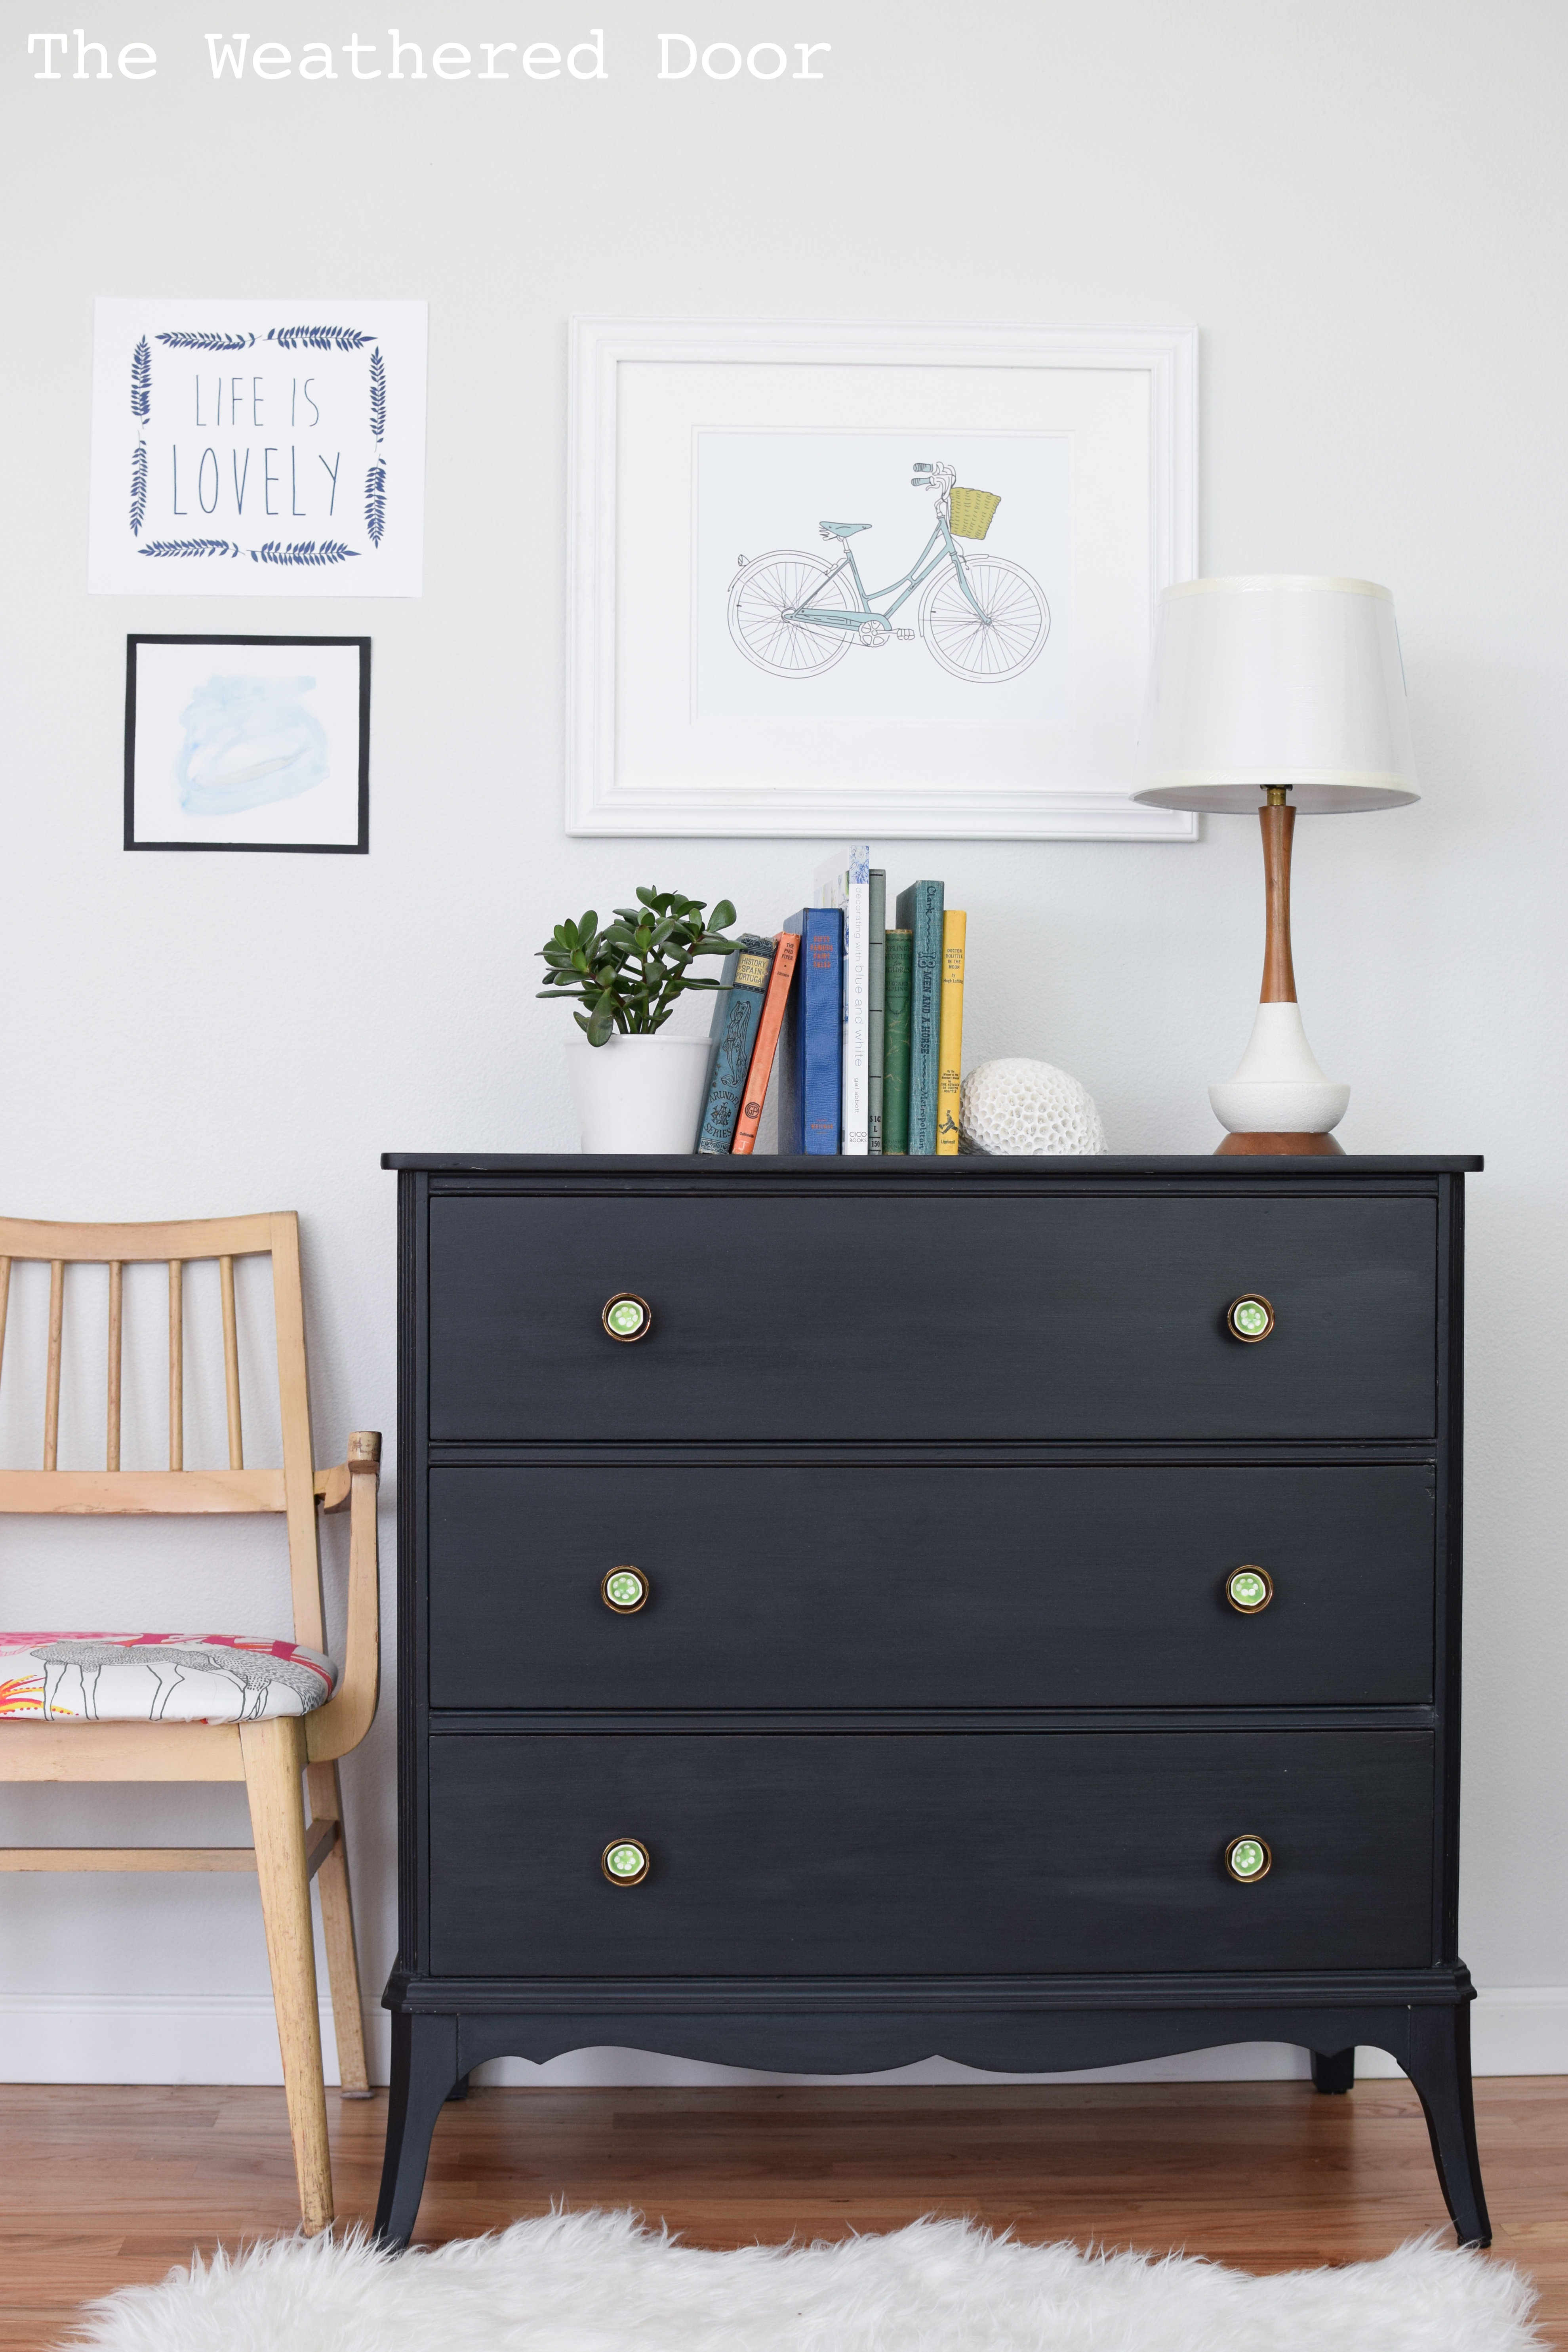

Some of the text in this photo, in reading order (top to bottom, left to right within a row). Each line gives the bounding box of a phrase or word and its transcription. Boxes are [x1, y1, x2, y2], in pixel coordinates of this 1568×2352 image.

[196, 374, 319, 427] LIFE IS
[173, 444, 341, 516] LOVELY
[854, 887, 862, 938] decorating
[926, 886, 937, 915] Clark
[741, 957, 767, 968] HISTORY
[741, 965, 762, 975] SPAIN
[855, 965, 864, 994] blue
[923, 970, 932, 993] MEN
[855, 999, 864, 1024] and
[922, 995, 931, 1014] AND
[855, 1029, 864, 1066] white
[920, 1026, 930, 1054] HORSE
[709, 1090, 740, 1108] ARUNDEL
[704, 1123, 732, 1138] SERIES
[917, 1088, 928, 1149] Metropolitan
